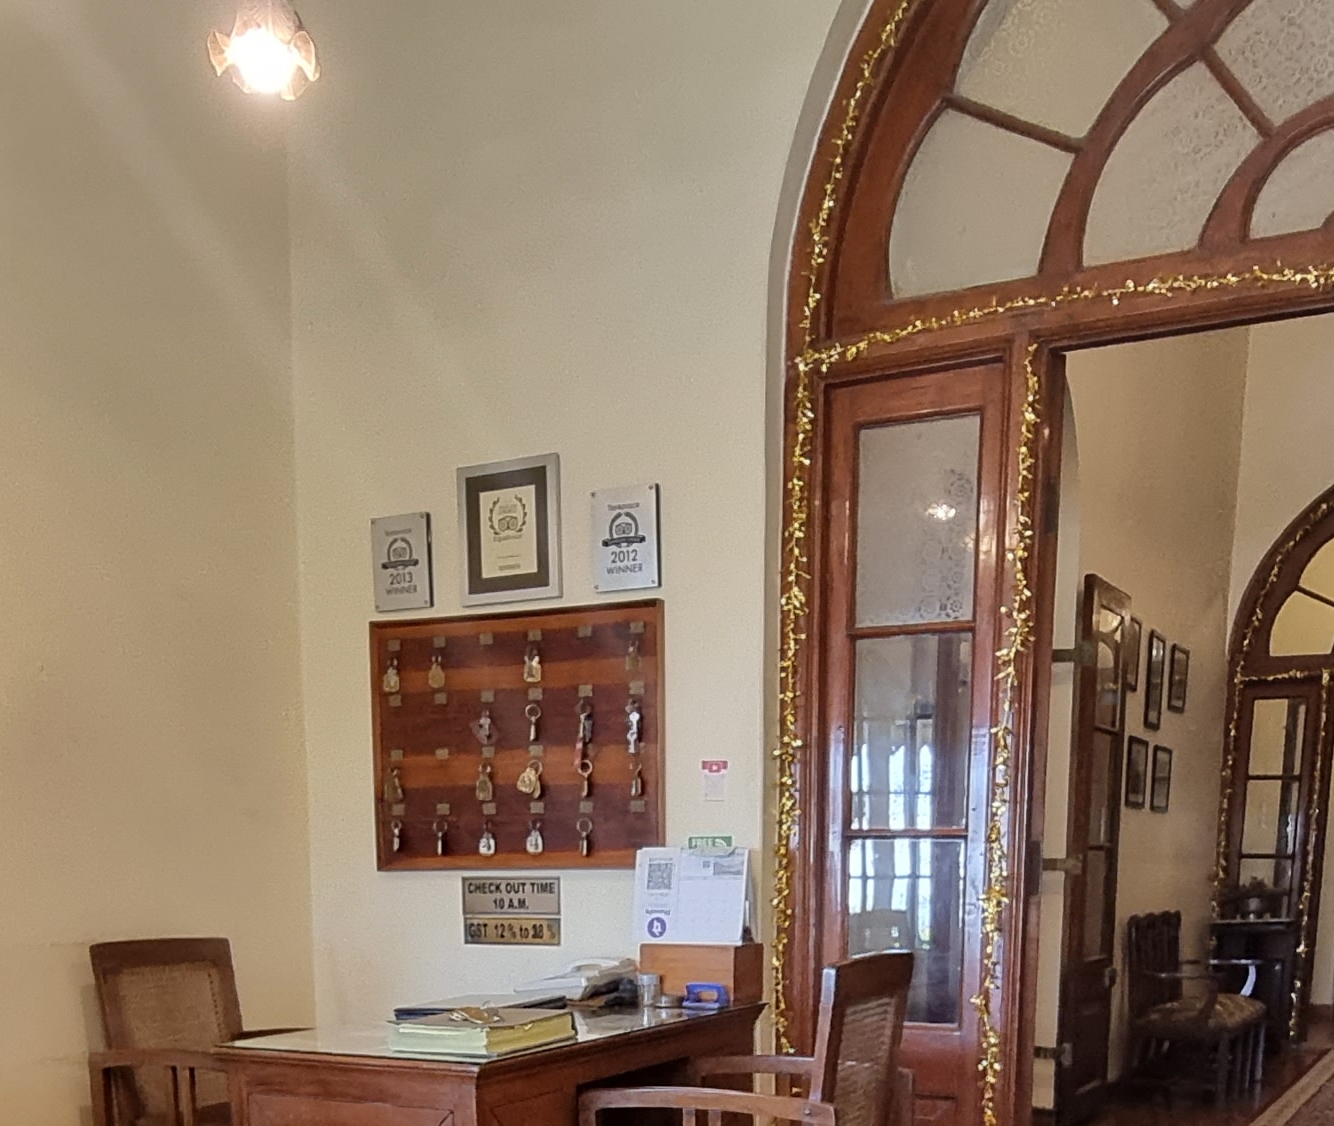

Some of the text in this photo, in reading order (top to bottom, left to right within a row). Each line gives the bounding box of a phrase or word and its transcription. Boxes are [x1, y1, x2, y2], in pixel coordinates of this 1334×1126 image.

[611, 549, 638, 564] 2012
[606, 563, 643, 575] WINNER
[389, 572, 413, 585] 2013
[468, 882, 555, 894] CHECK OUT TIME
[493, 898, 529, 910] 10 A.M.
[469, 923, 488, 938] GST
